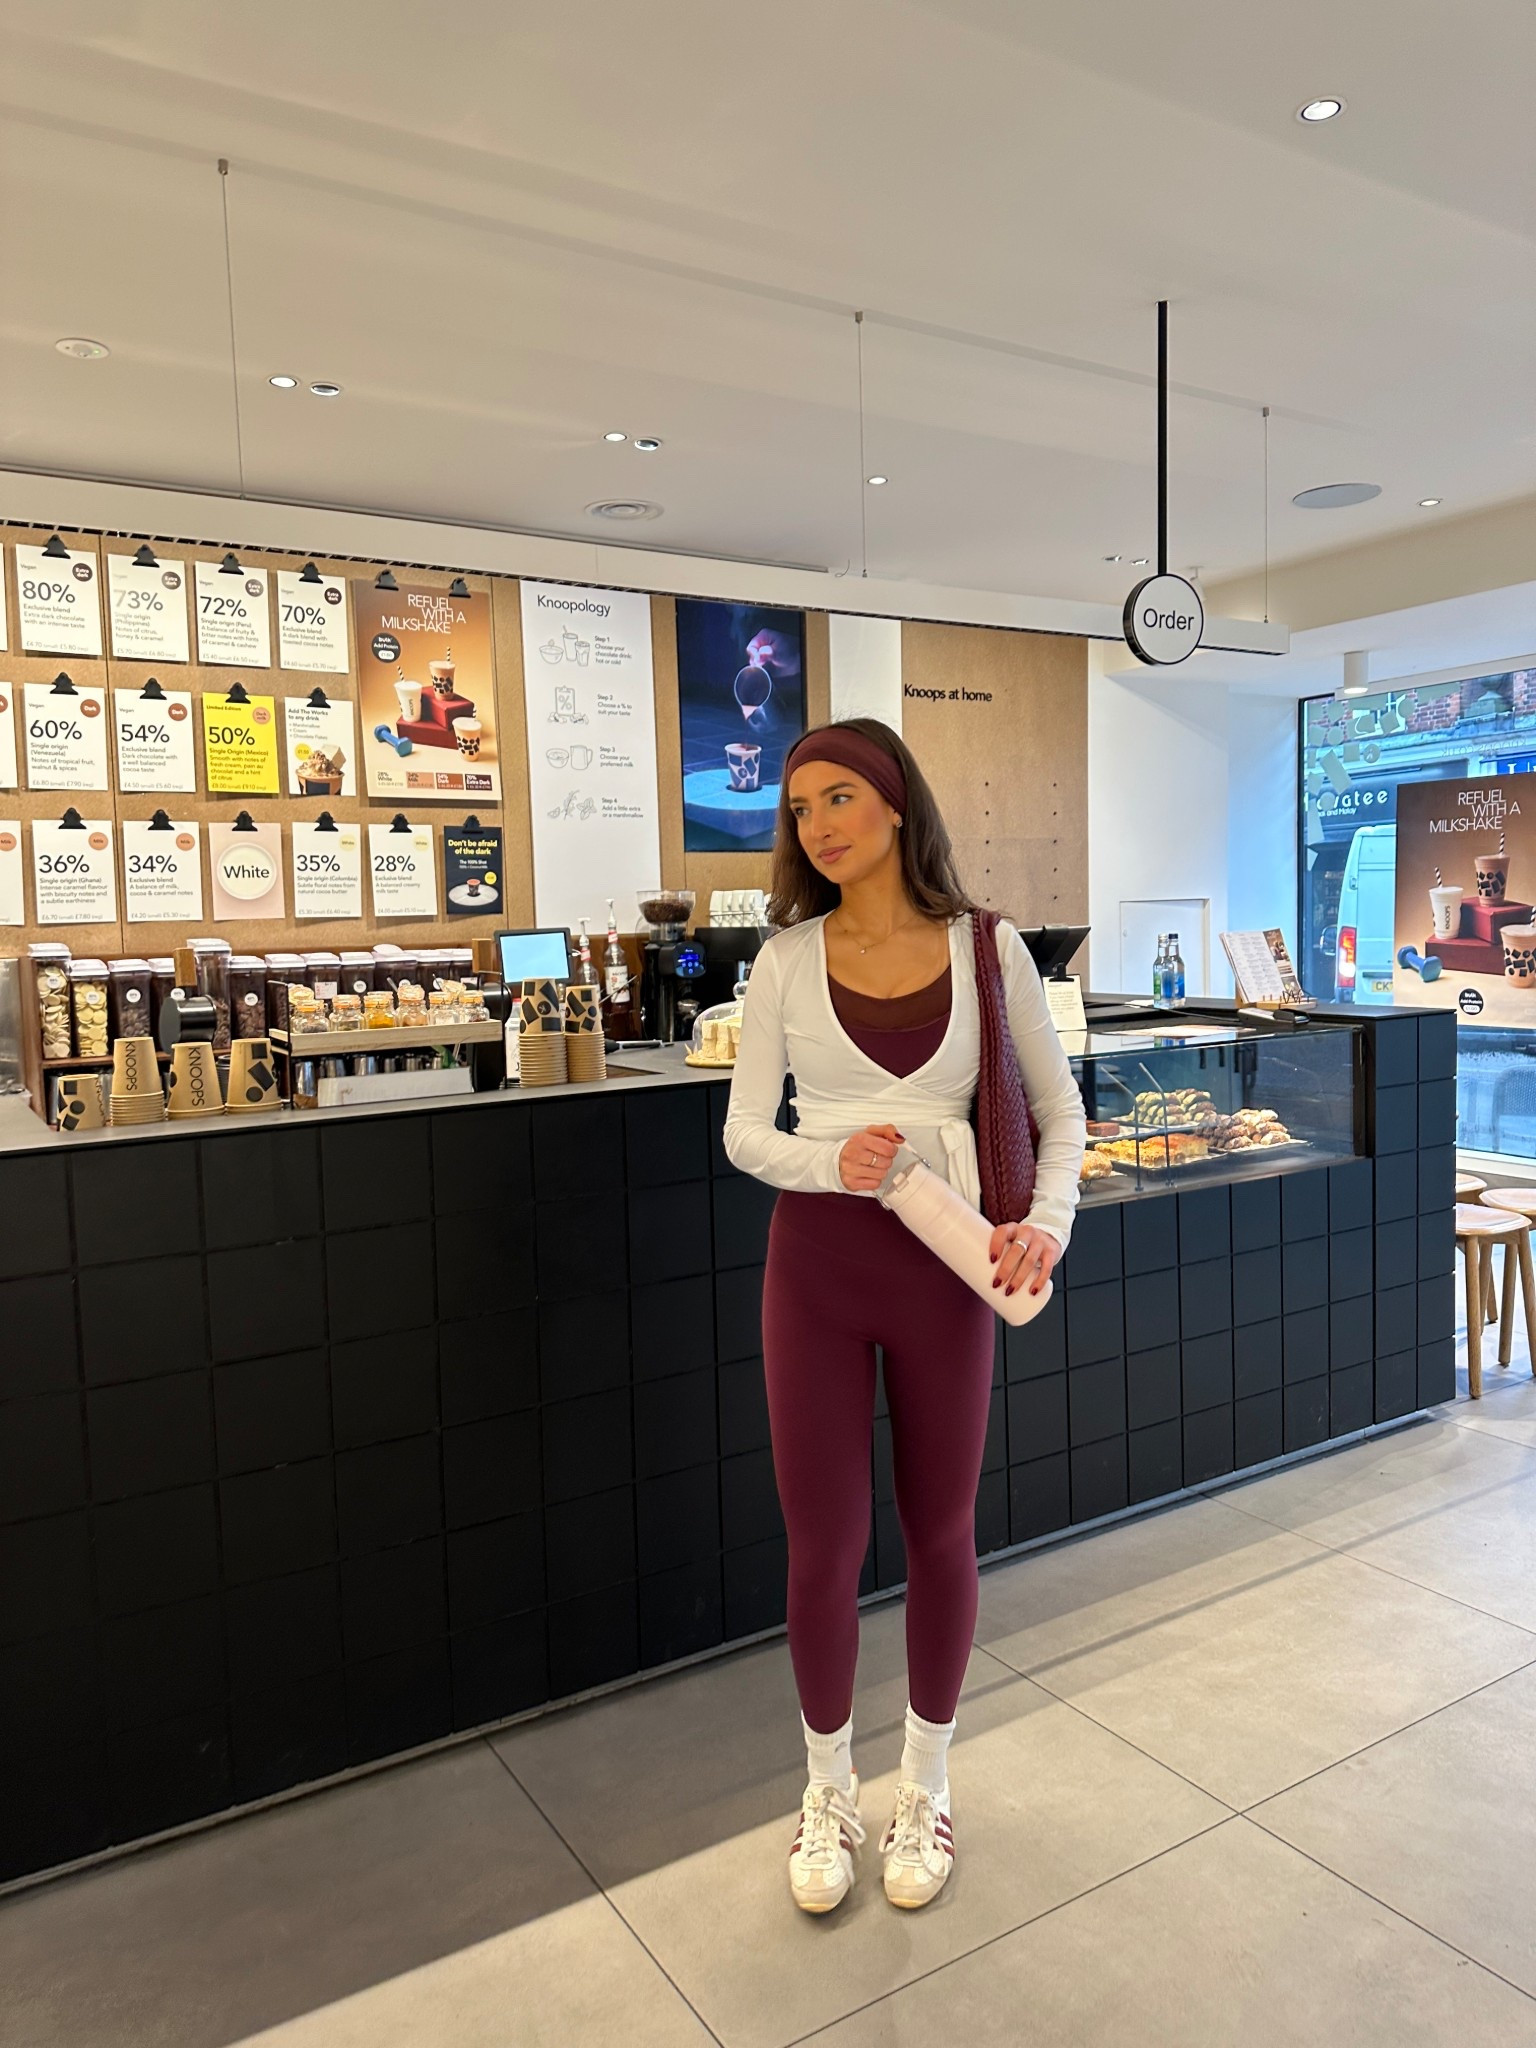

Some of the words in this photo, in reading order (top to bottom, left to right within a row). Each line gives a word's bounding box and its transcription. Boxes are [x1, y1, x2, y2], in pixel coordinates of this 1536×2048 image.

[22, 580, 76, 604] 80%
[113, 589, 164, 611] 73%
[200, 595, 247, 618] 72%
[407, 593, 453, 611] REFUEL
[537, 594, 611, 618] Knoopology
[201, 617, 218, 625] Single
[281, 604, 326, 626] 70%
[381, 615, 451, 634] MILKSHAKE
[421, 607, 454, 623] WITH
[456, 611, 467, 624] A
[1143, 608, 1195, 631] Order
[282, 625, 306, 634] Exclusive
[904, 683, 946, 702] Knoops
[949, 689, 960, 700] at
[962, 686, 993, 702] home
[30, 719, 82, 740] 60%
[121, 724, 170, 743] 54%
[209, 726, 255, 746] 50%
[30, 742, 49, 750] Single
[1458, 789, 1507, 806] REFUEL
[1339, 807, 1357, 815] Malay
[1472, 802, 1507, 818] WITH
[1509, 801, 1521, 816] A
[1429, 816, 1503, 834] MILKSHAKE
[448, 839, 466, 847] Don't
[468, 839, 477, 847] be
[478, 839, 498, 847] afraid
[475, 847, 491, 855] dark
[38, 854, 90, 874] 36%
[128, 854, 178, 873] 34%
[223, 865, 270, 879] White
[297, 854, 341, 872] 35%
[374, 855, 416, 872] 28%
[125, 1041, 138, 1091] KNOOPS
[188, 1047, 205, 1107] KNOOPS
